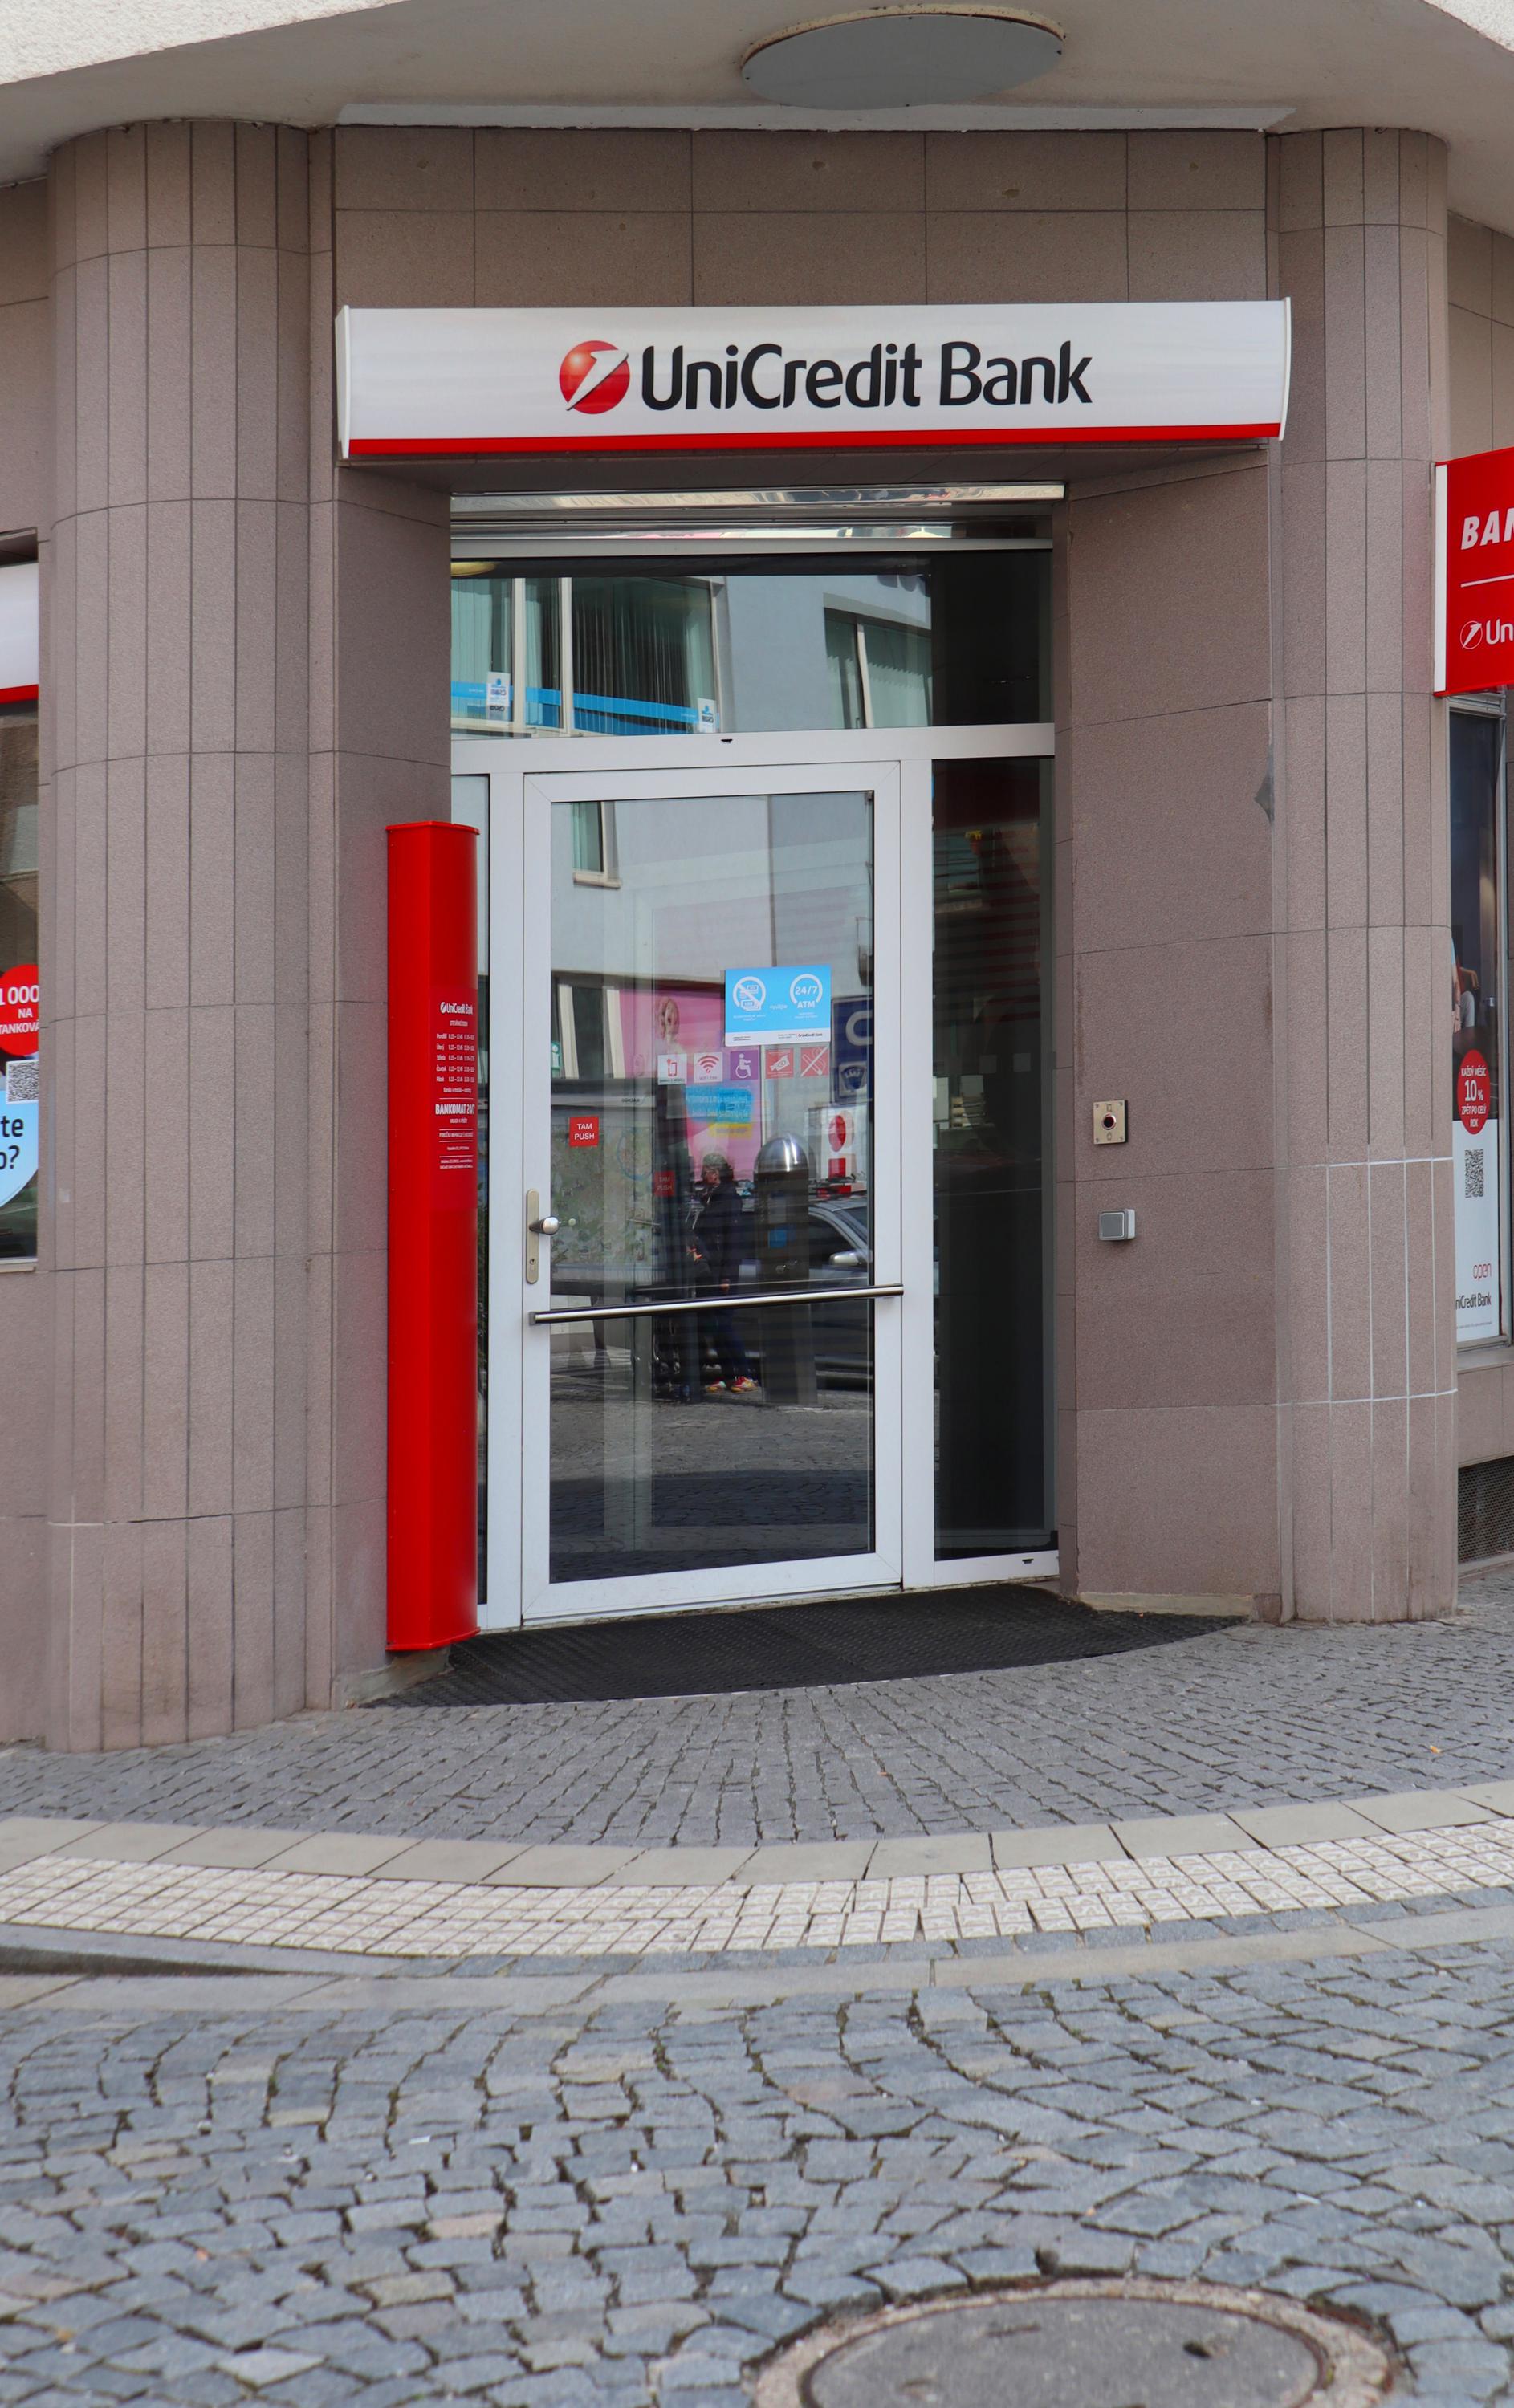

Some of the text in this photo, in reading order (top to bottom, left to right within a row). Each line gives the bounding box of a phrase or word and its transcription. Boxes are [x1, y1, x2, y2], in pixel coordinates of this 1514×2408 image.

[642, 340, 1093, 410] UniCredit Bank
[1486, 618, 1514, 645] Un
[796, 986, 818, 995] 24/7
[18, 1007, 33, 1019] NA
[796, 1000, 816, 1009] ATM
[1464, 1080, 1484, 1102] 10 %
[435, 1104, 466, 1115] BANKOMAT
[1, 1115, 24, 1137] te
[574, 1133, 595, 1141] PUSH
[1473, 1263, 1492, 1281] open
[1477, 1291, 1492, 1308] Bank
